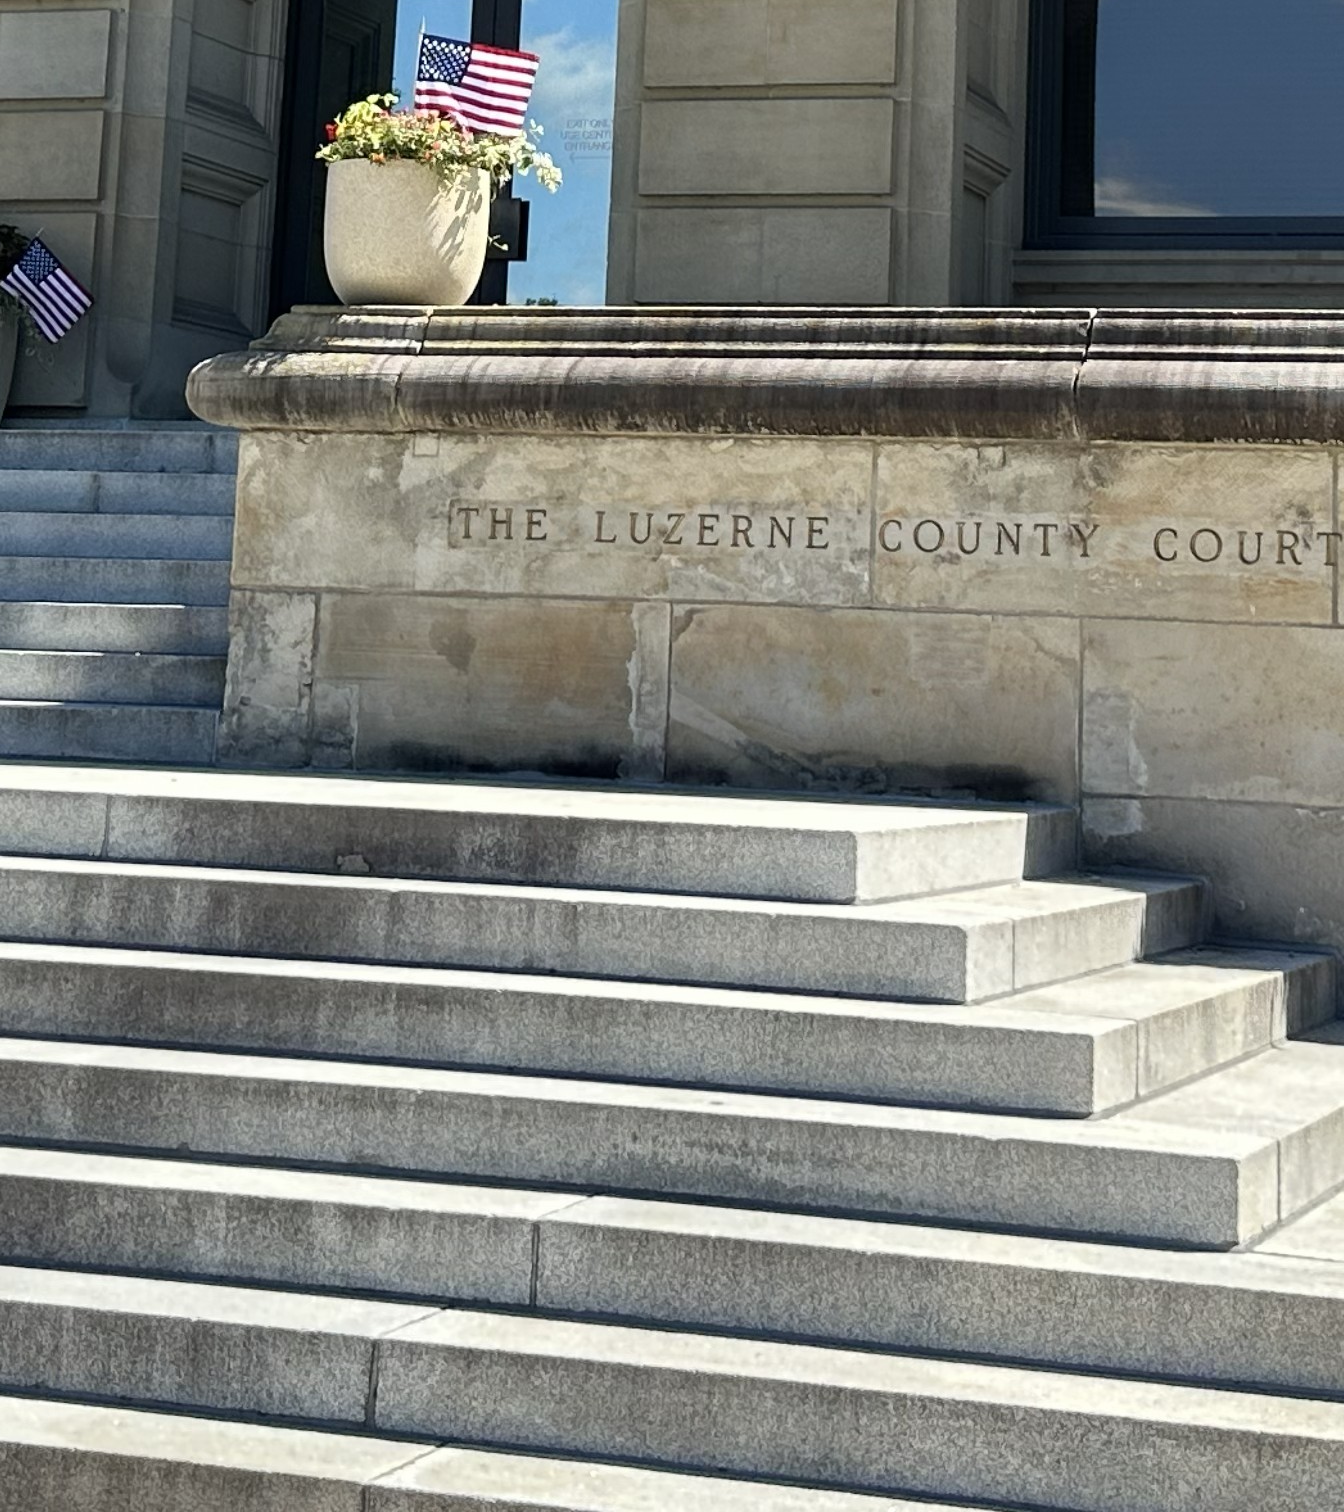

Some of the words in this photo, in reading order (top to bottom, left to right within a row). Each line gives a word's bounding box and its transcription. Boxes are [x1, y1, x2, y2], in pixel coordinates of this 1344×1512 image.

[567, 118, 587, 129] EXIT
[590, 118, 613, 129] ONL
[457, 507, 548, 541] THE
[594, 511, 830, 550] LUZERNE
[878, 519, 1100, 558] COUNTY
[1153, 528, 1343, 567] COURT
